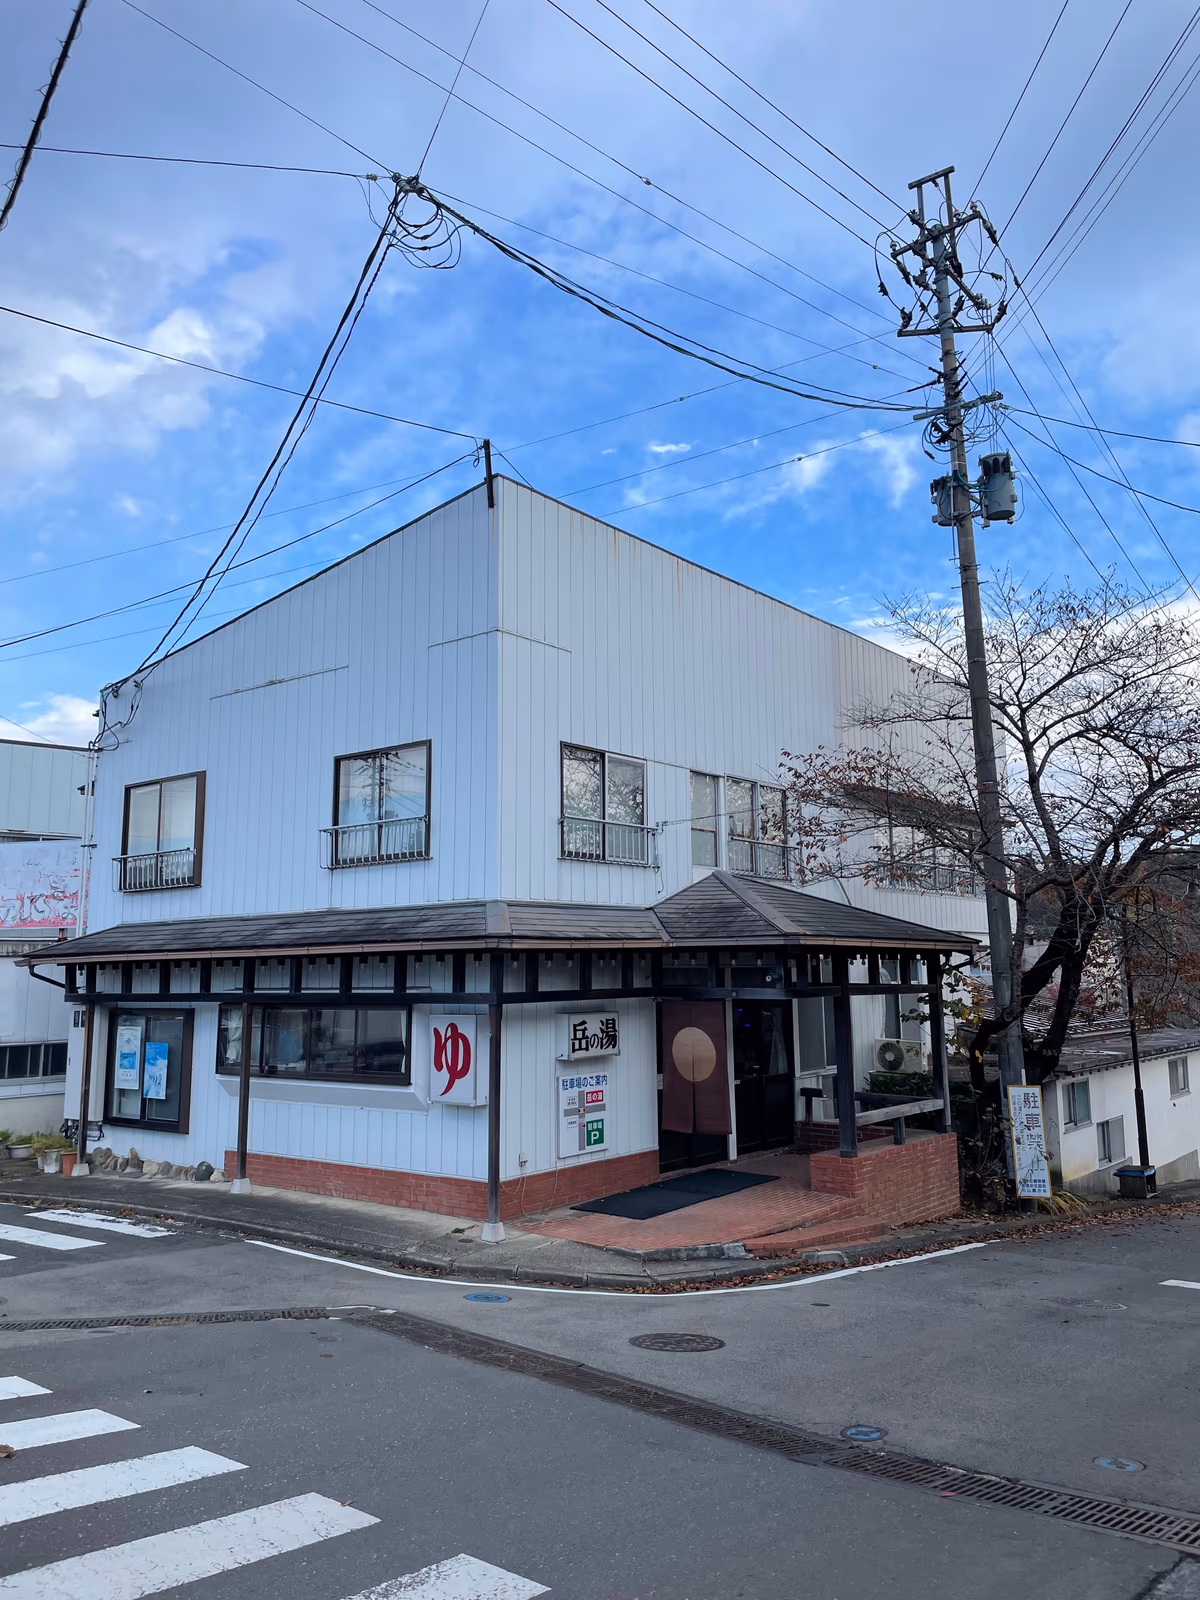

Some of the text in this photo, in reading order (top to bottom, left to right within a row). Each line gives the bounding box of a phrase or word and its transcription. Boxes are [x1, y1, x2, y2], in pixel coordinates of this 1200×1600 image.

[571, 1017, 618, 1053] 岳の湯
[433, 1021, 472, 1097] ゆ
[562, 1074, 608, 1091] 駐車場のご案内
[587, 1121, 603, 1131] 駐車場
[591, 1131, 600, 1144] P
